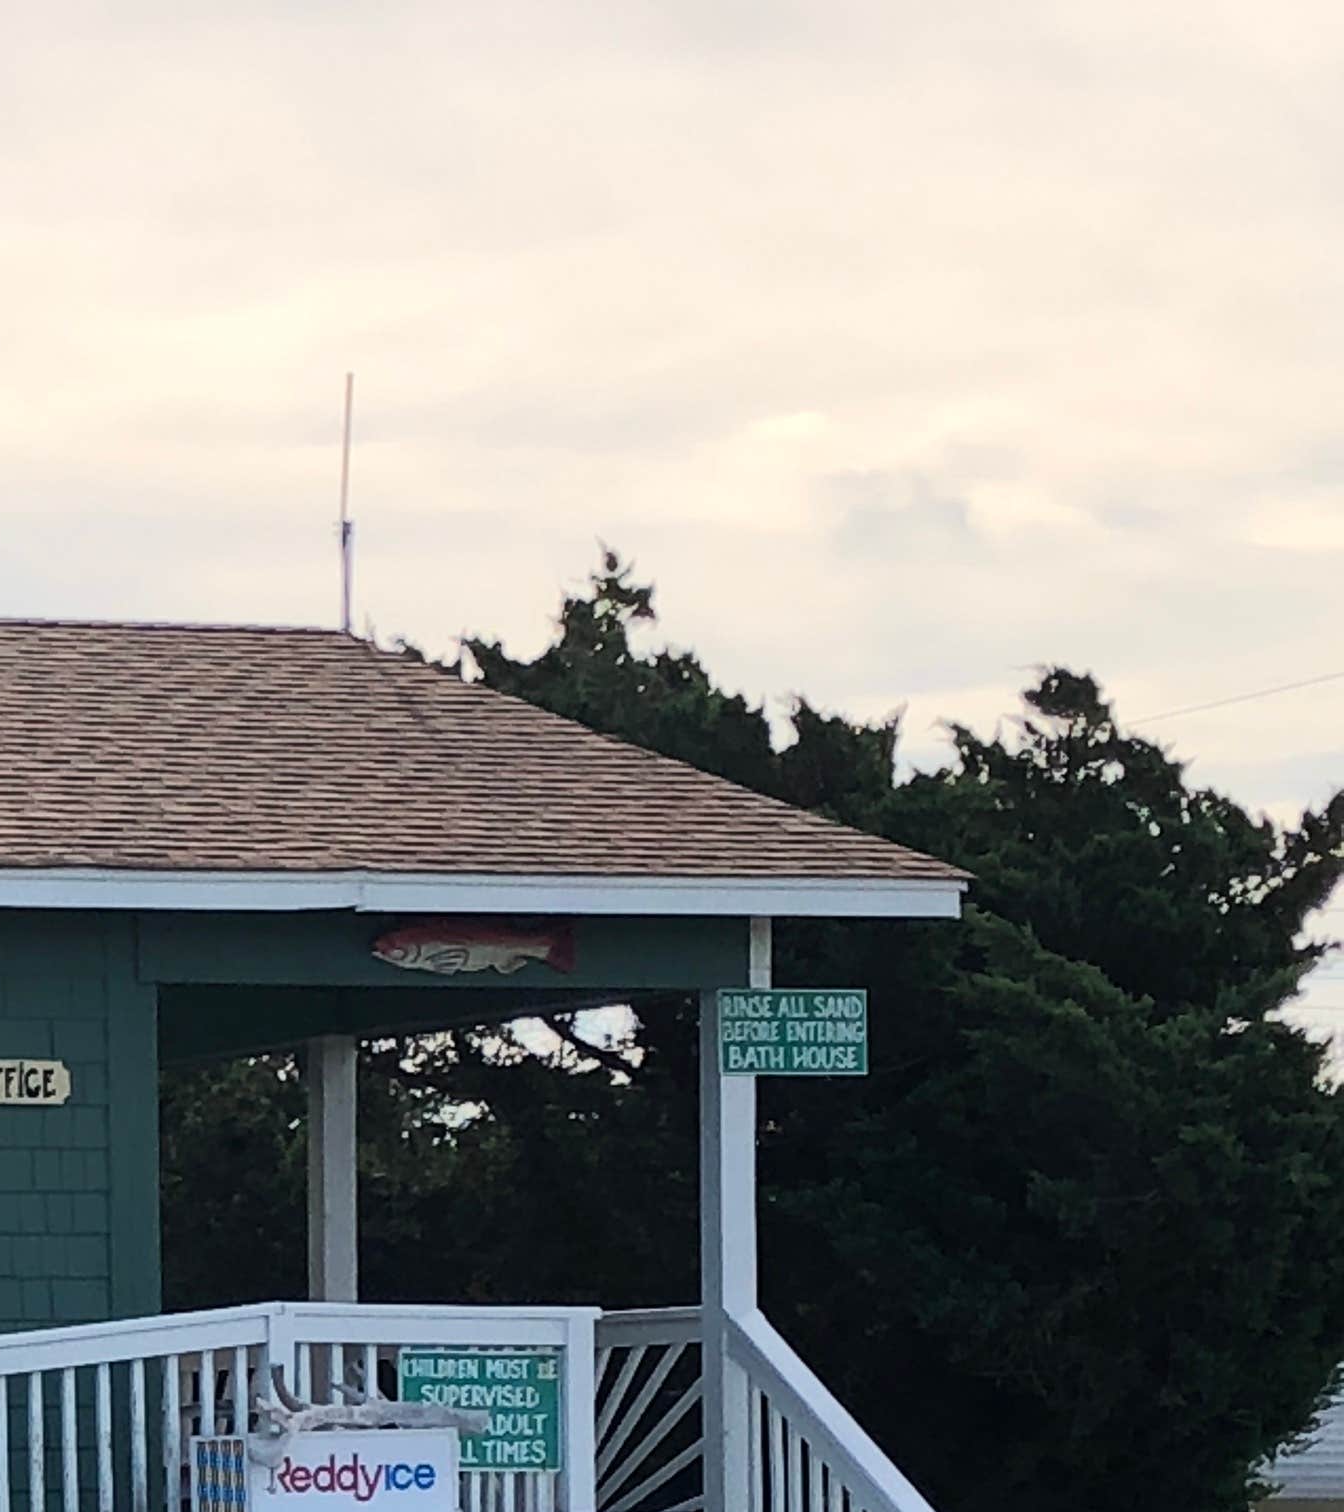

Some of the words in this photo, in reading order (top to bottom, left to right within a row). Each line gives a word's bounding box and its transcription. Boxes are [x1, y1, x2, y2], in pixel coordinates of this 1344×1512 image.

[777, 995, 810, 1018] ALL
[814, 995, 862, 1018] SAND
[723, 1021, 781, 1042] BEFORE
[786, 1021, 864, 1043] ENTERING
[728, 1046, 785, 1069] BATH
[792, 1046, 858, 1069] HOUSE
[403, 1358, 479, 1379] CHILDREN
[420, 1383, 541, 1409] SUPERVISED
[484, 1413, 549, 1436] ADULT
[481, 1439, 547, 1464] TIMES
